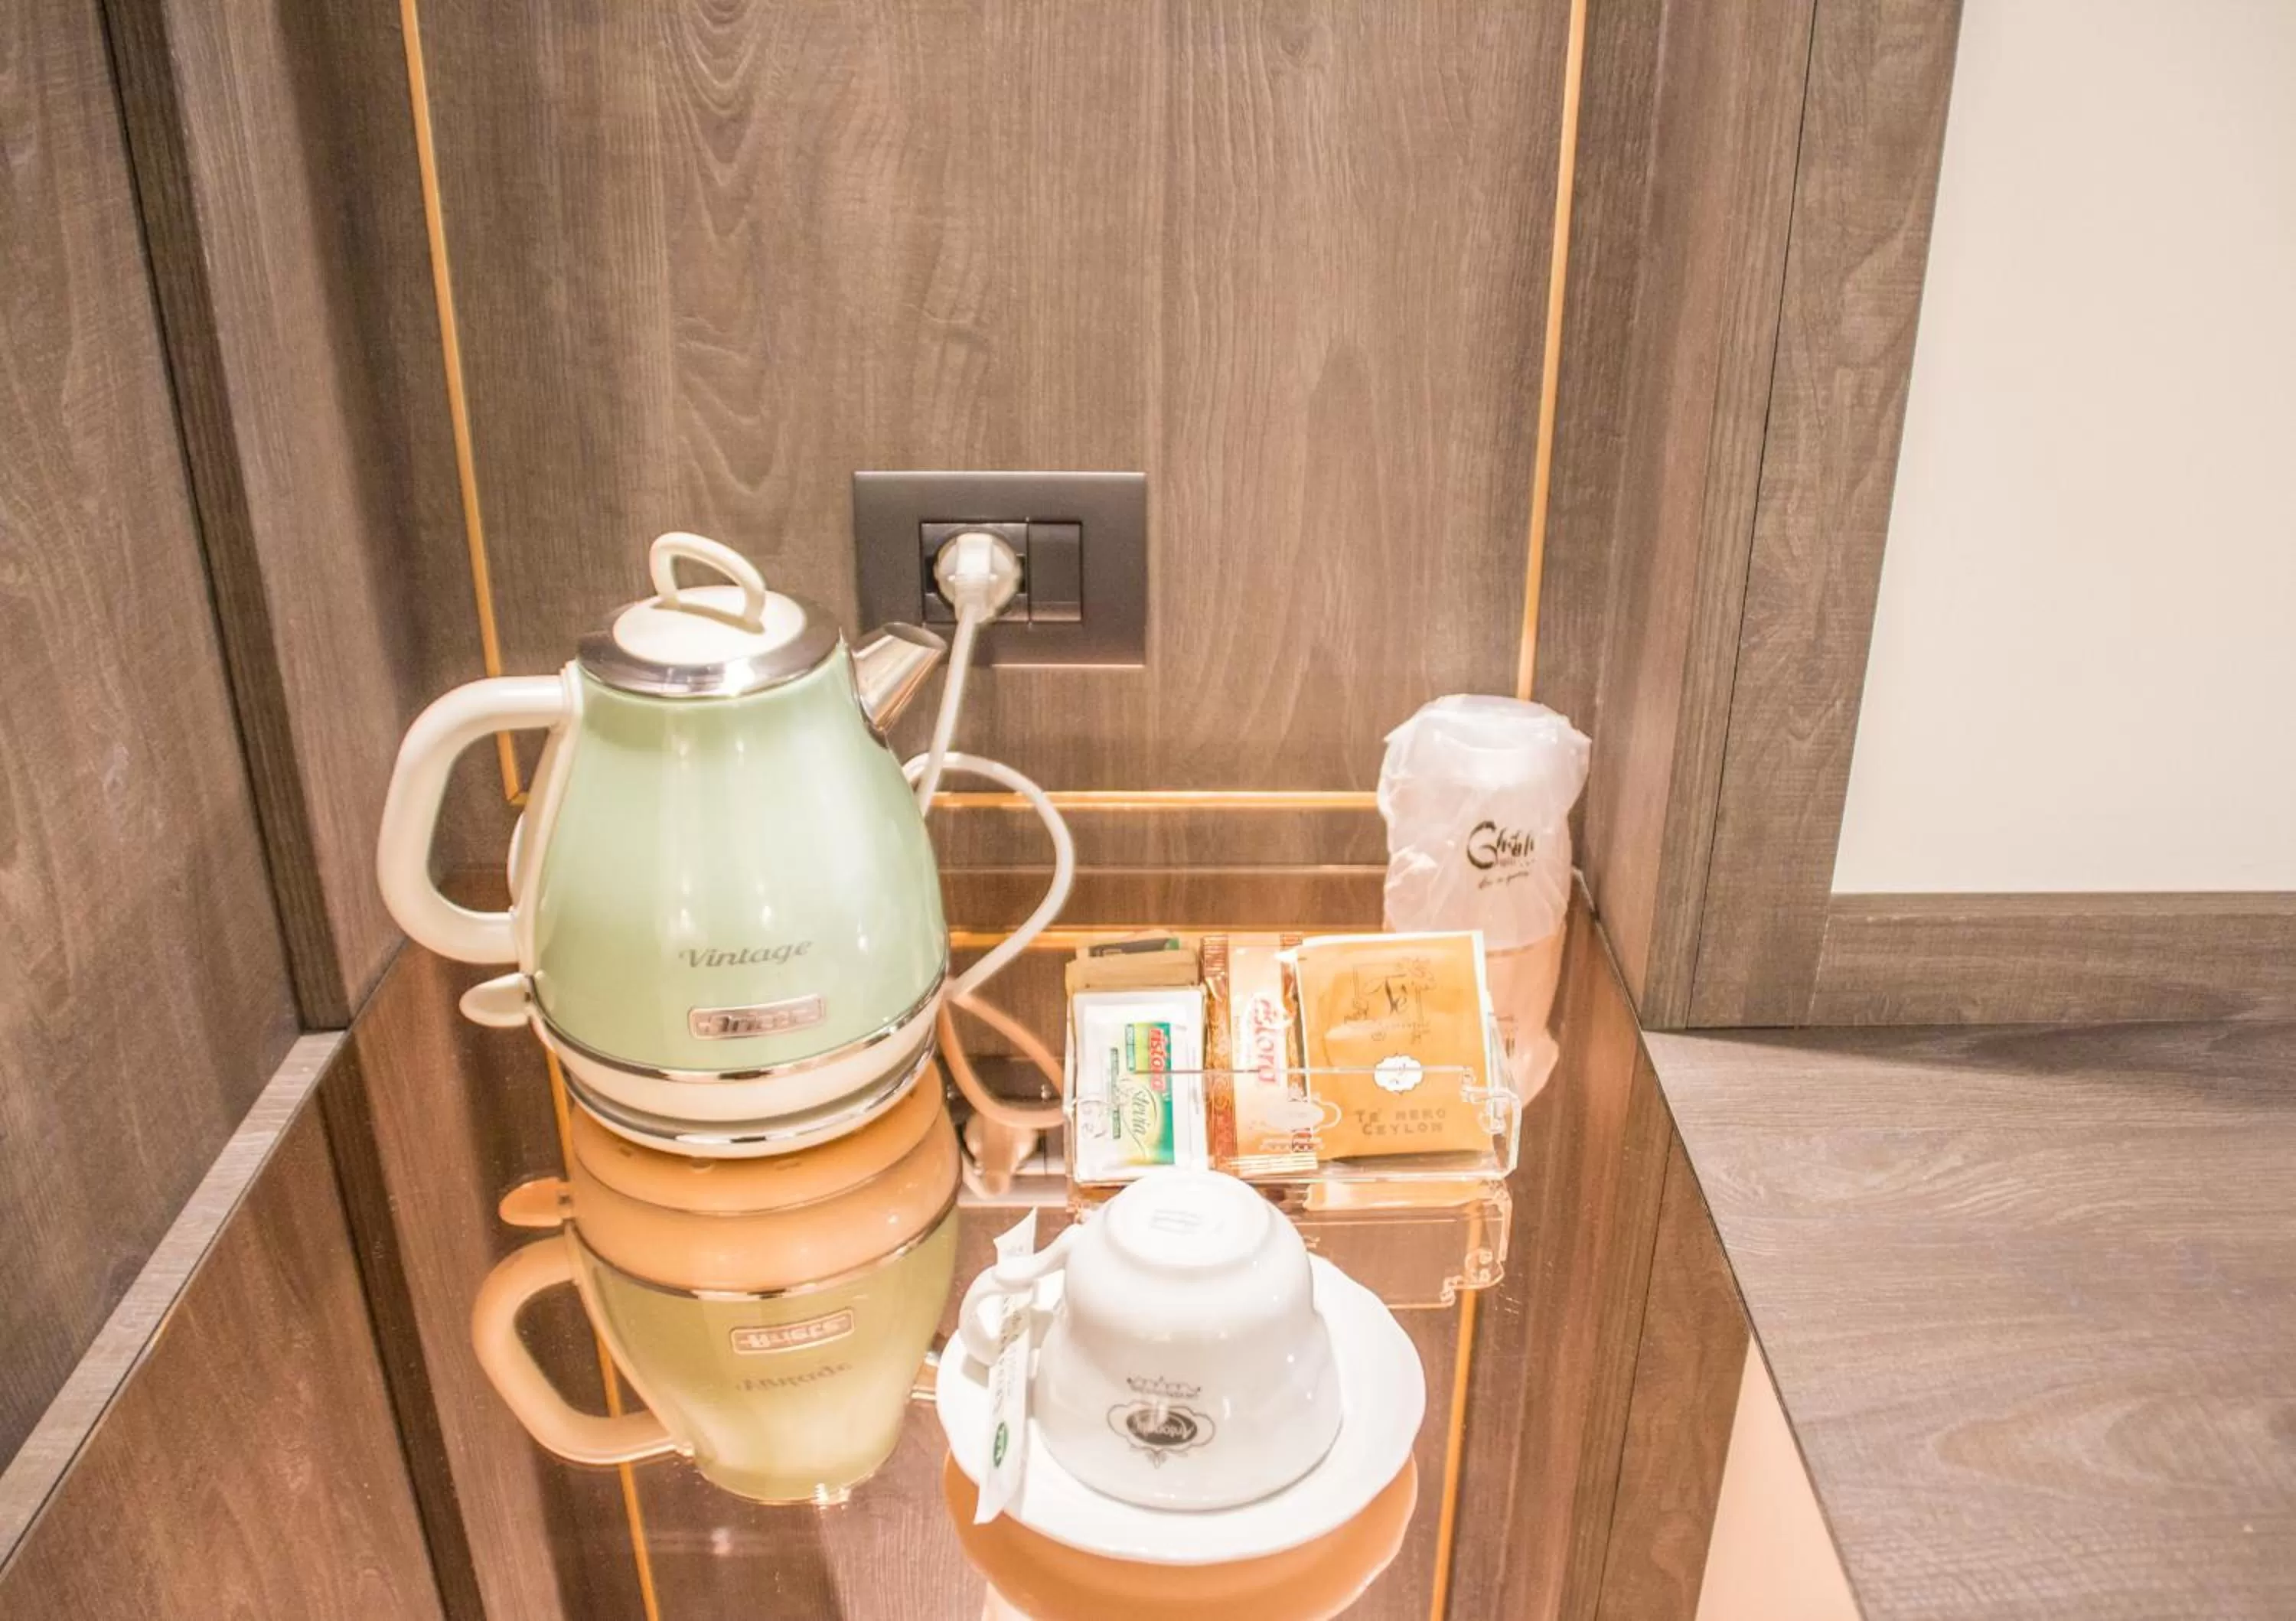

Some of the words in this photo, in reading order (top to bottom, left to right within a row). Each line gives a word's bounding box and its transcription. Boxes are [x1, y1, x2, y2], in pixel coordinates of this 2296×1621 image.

[678, 940, 812, 968] Vintage
[1150, 1029, 1168, 1091] ristoa
[1362, 1121, 1443, 1135] CEYLON
